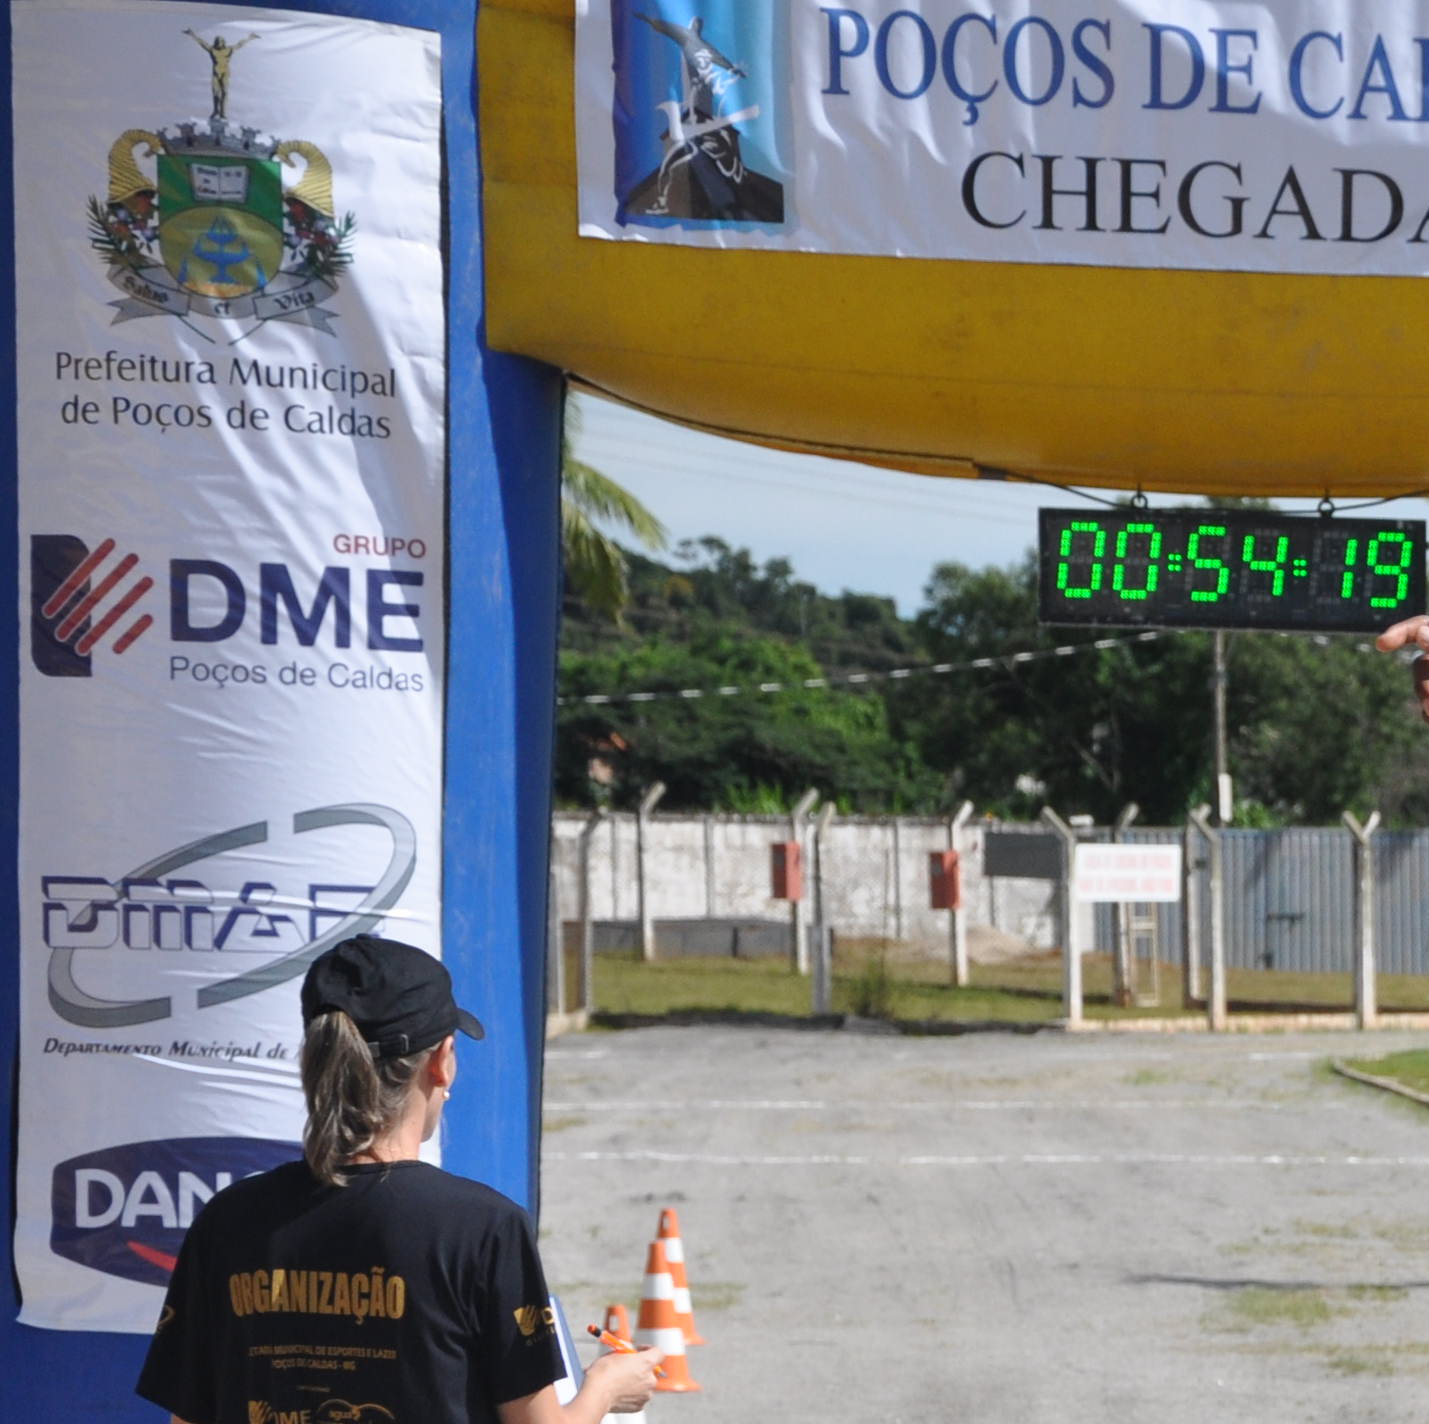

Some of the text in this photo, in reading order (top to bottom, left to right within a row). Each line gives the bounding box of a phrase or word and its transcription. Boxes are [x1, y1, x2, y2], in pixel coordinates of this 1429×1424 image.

[821, 8, 1115, 126] POÇOS
[1141, 22, 1264, 115] DE
[55, 350, 396, 398] Prefeitura Municipal
[61, 394, 391, 439] de Poços de Caldas
[333, 533, 427, 559] GRUPO
[1056, 521, 1413, 608] 00:54:19
[169, 558, 425, 653] DME
[169, 656, 424, 692] Poços de Caldas
[75, 1168, 266, 1229] DAN
[229, 1265, 406, 1326] ORGANIZAÇÃO
